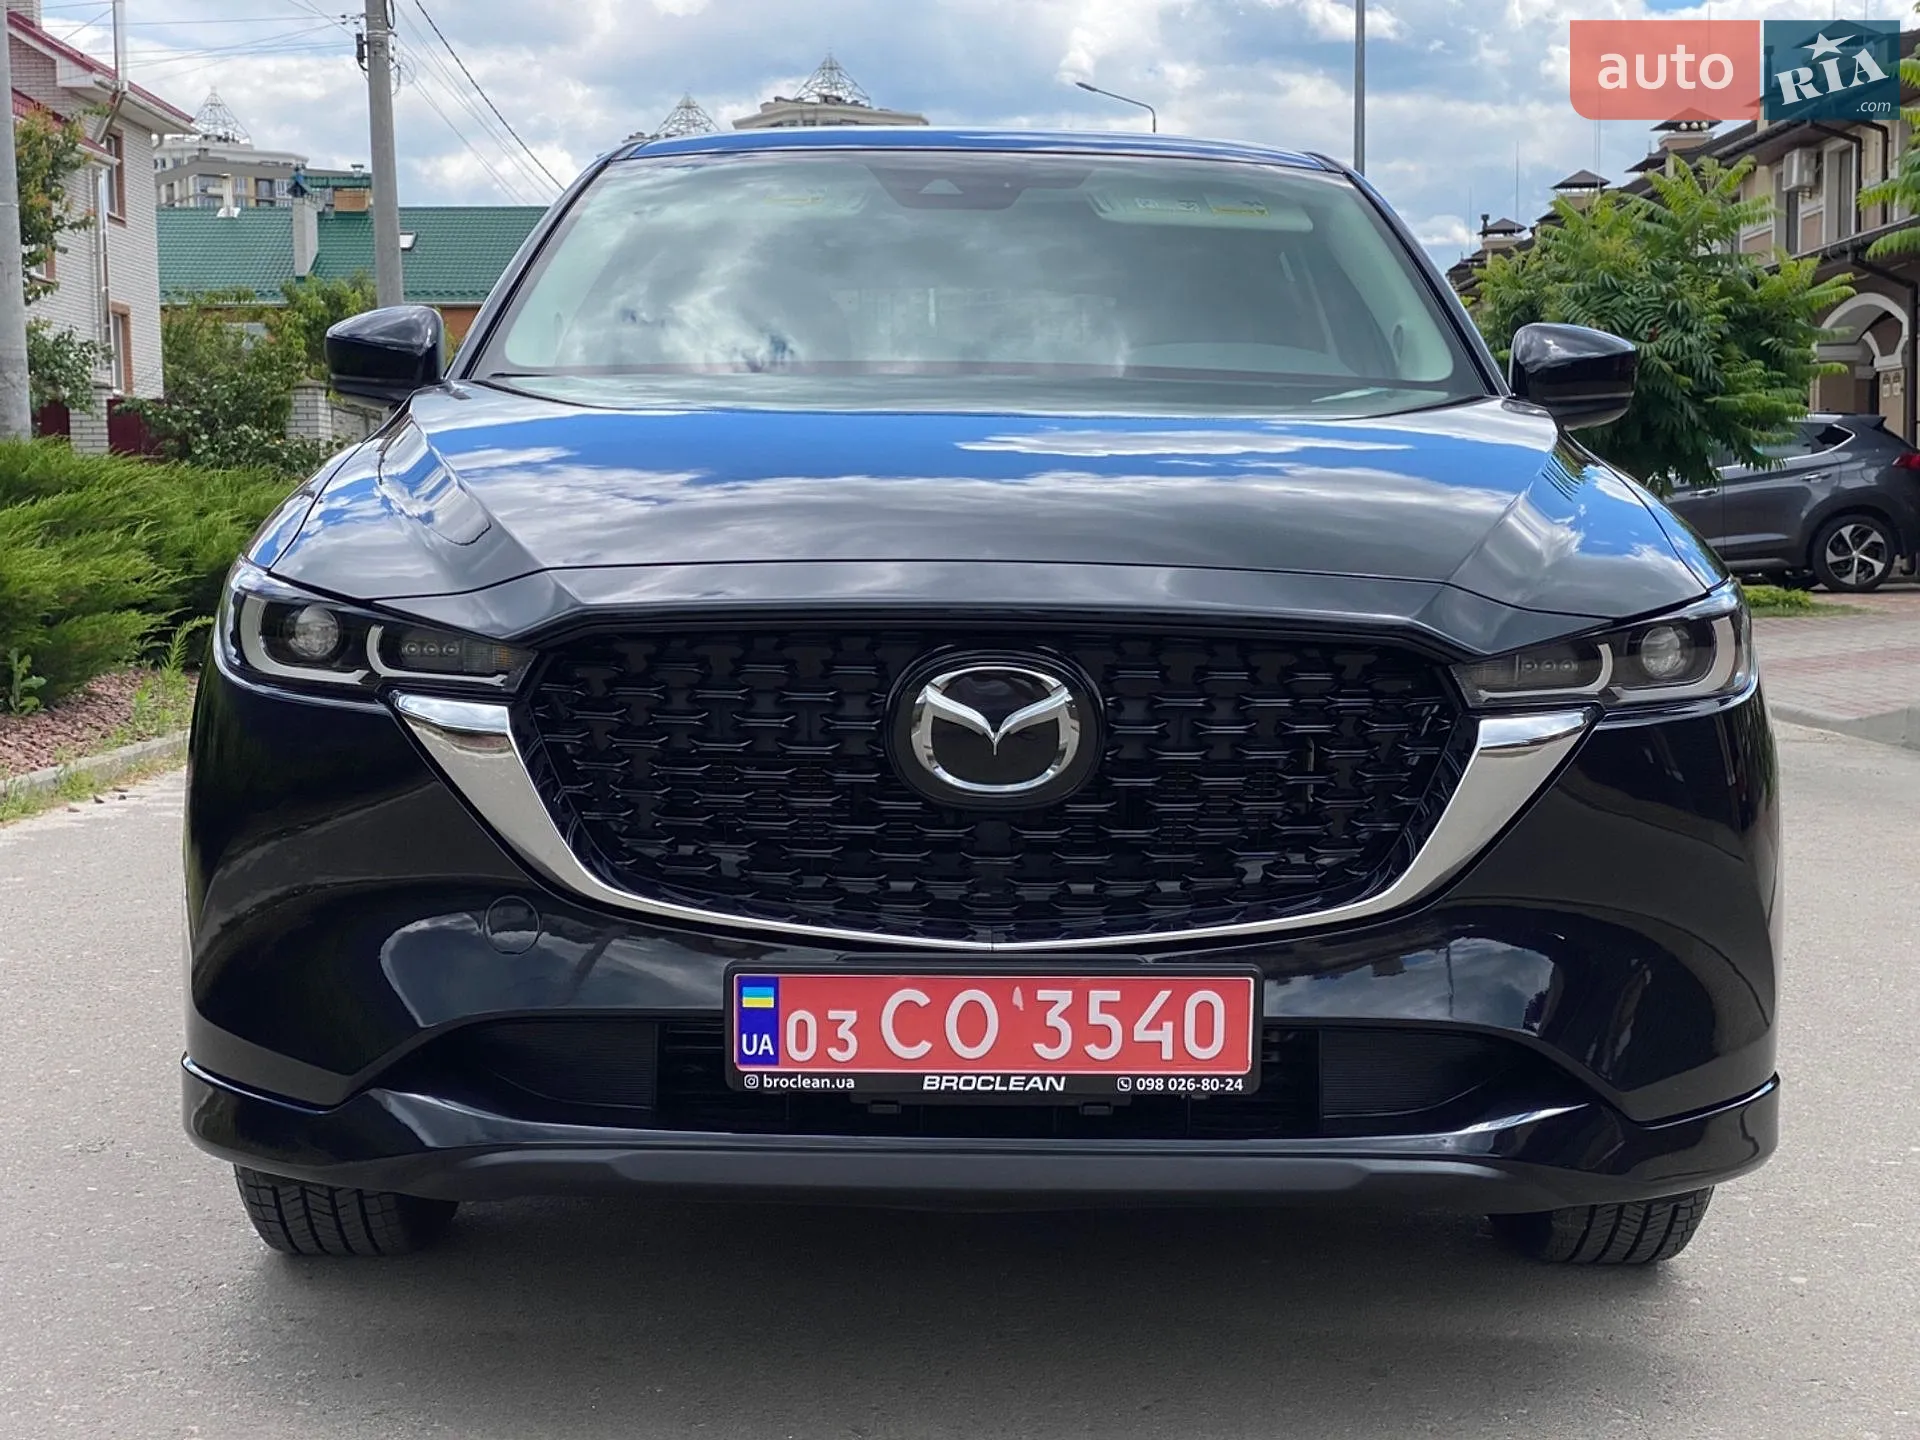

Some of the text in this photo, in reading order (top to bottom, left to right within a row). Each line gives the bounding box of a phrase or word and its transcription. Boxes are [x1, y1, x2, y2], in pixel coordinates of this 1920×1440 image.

[786, 988, 1225, 1062] 03 CO 3540
[742, 1033, 775, 1056] UA
[763, 1075, 855, 1089] broclean.ua
[922, 1076, 1066, 1091] BROCLEAN
[1136, 1078, 1244, 1091] 098 026-80-24
